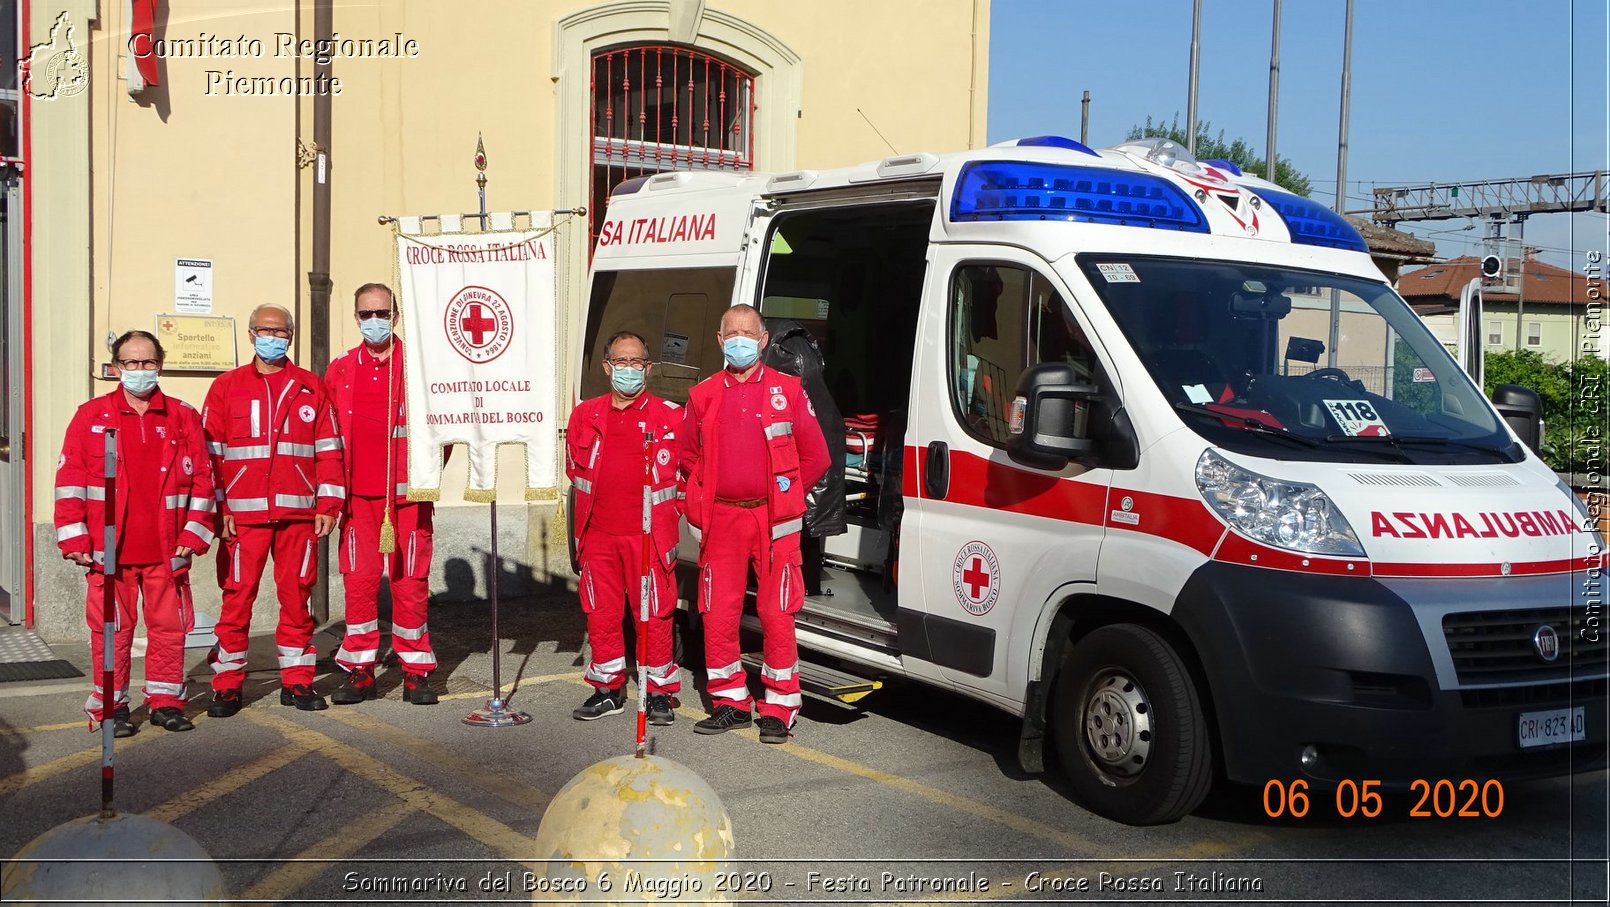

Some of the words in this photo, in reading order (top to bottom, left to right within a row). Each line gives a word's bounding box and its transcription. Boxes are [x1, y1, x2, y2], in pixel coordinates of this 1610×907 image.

[627, 213, 716, 244] ITALIANA
[406, 245, 445, 264] CROCE
[449, 244, 485, 263] ROSSA
[487, 241, 547, 261] ITALIANA
[456, 298, 465, 308] DI
[491, 299, 502, 310] 22
[449, 307, 472, 356] CONVENZIONE
[498, 309, 509, 341] AGOSTO
[177, 333, 215, 342] Sportello
[485, 341, 502, 356] 1864
[430, 381, 482, 394] COMITATO
[485, 380, 531, 392] LOCALE
[475, 396, 484, 408] DI
[426, 412, 480, 425] SOMMARIVA
[482, 412, 503, 424] DEL
[507, 411, 544, 423] BOSCO
[1335, 402, 1377, 421] 118
[955, 551, 967, 574] CROCE
[967, 543, 983, 554] ROSSA
[982, 547, 998, 581] ITALIANA
[955, 580, 982, 613] SOMMARIVA
[982, 588, 998, 611] BOSCO
[1541, 635, 1554, 652] FIAT
